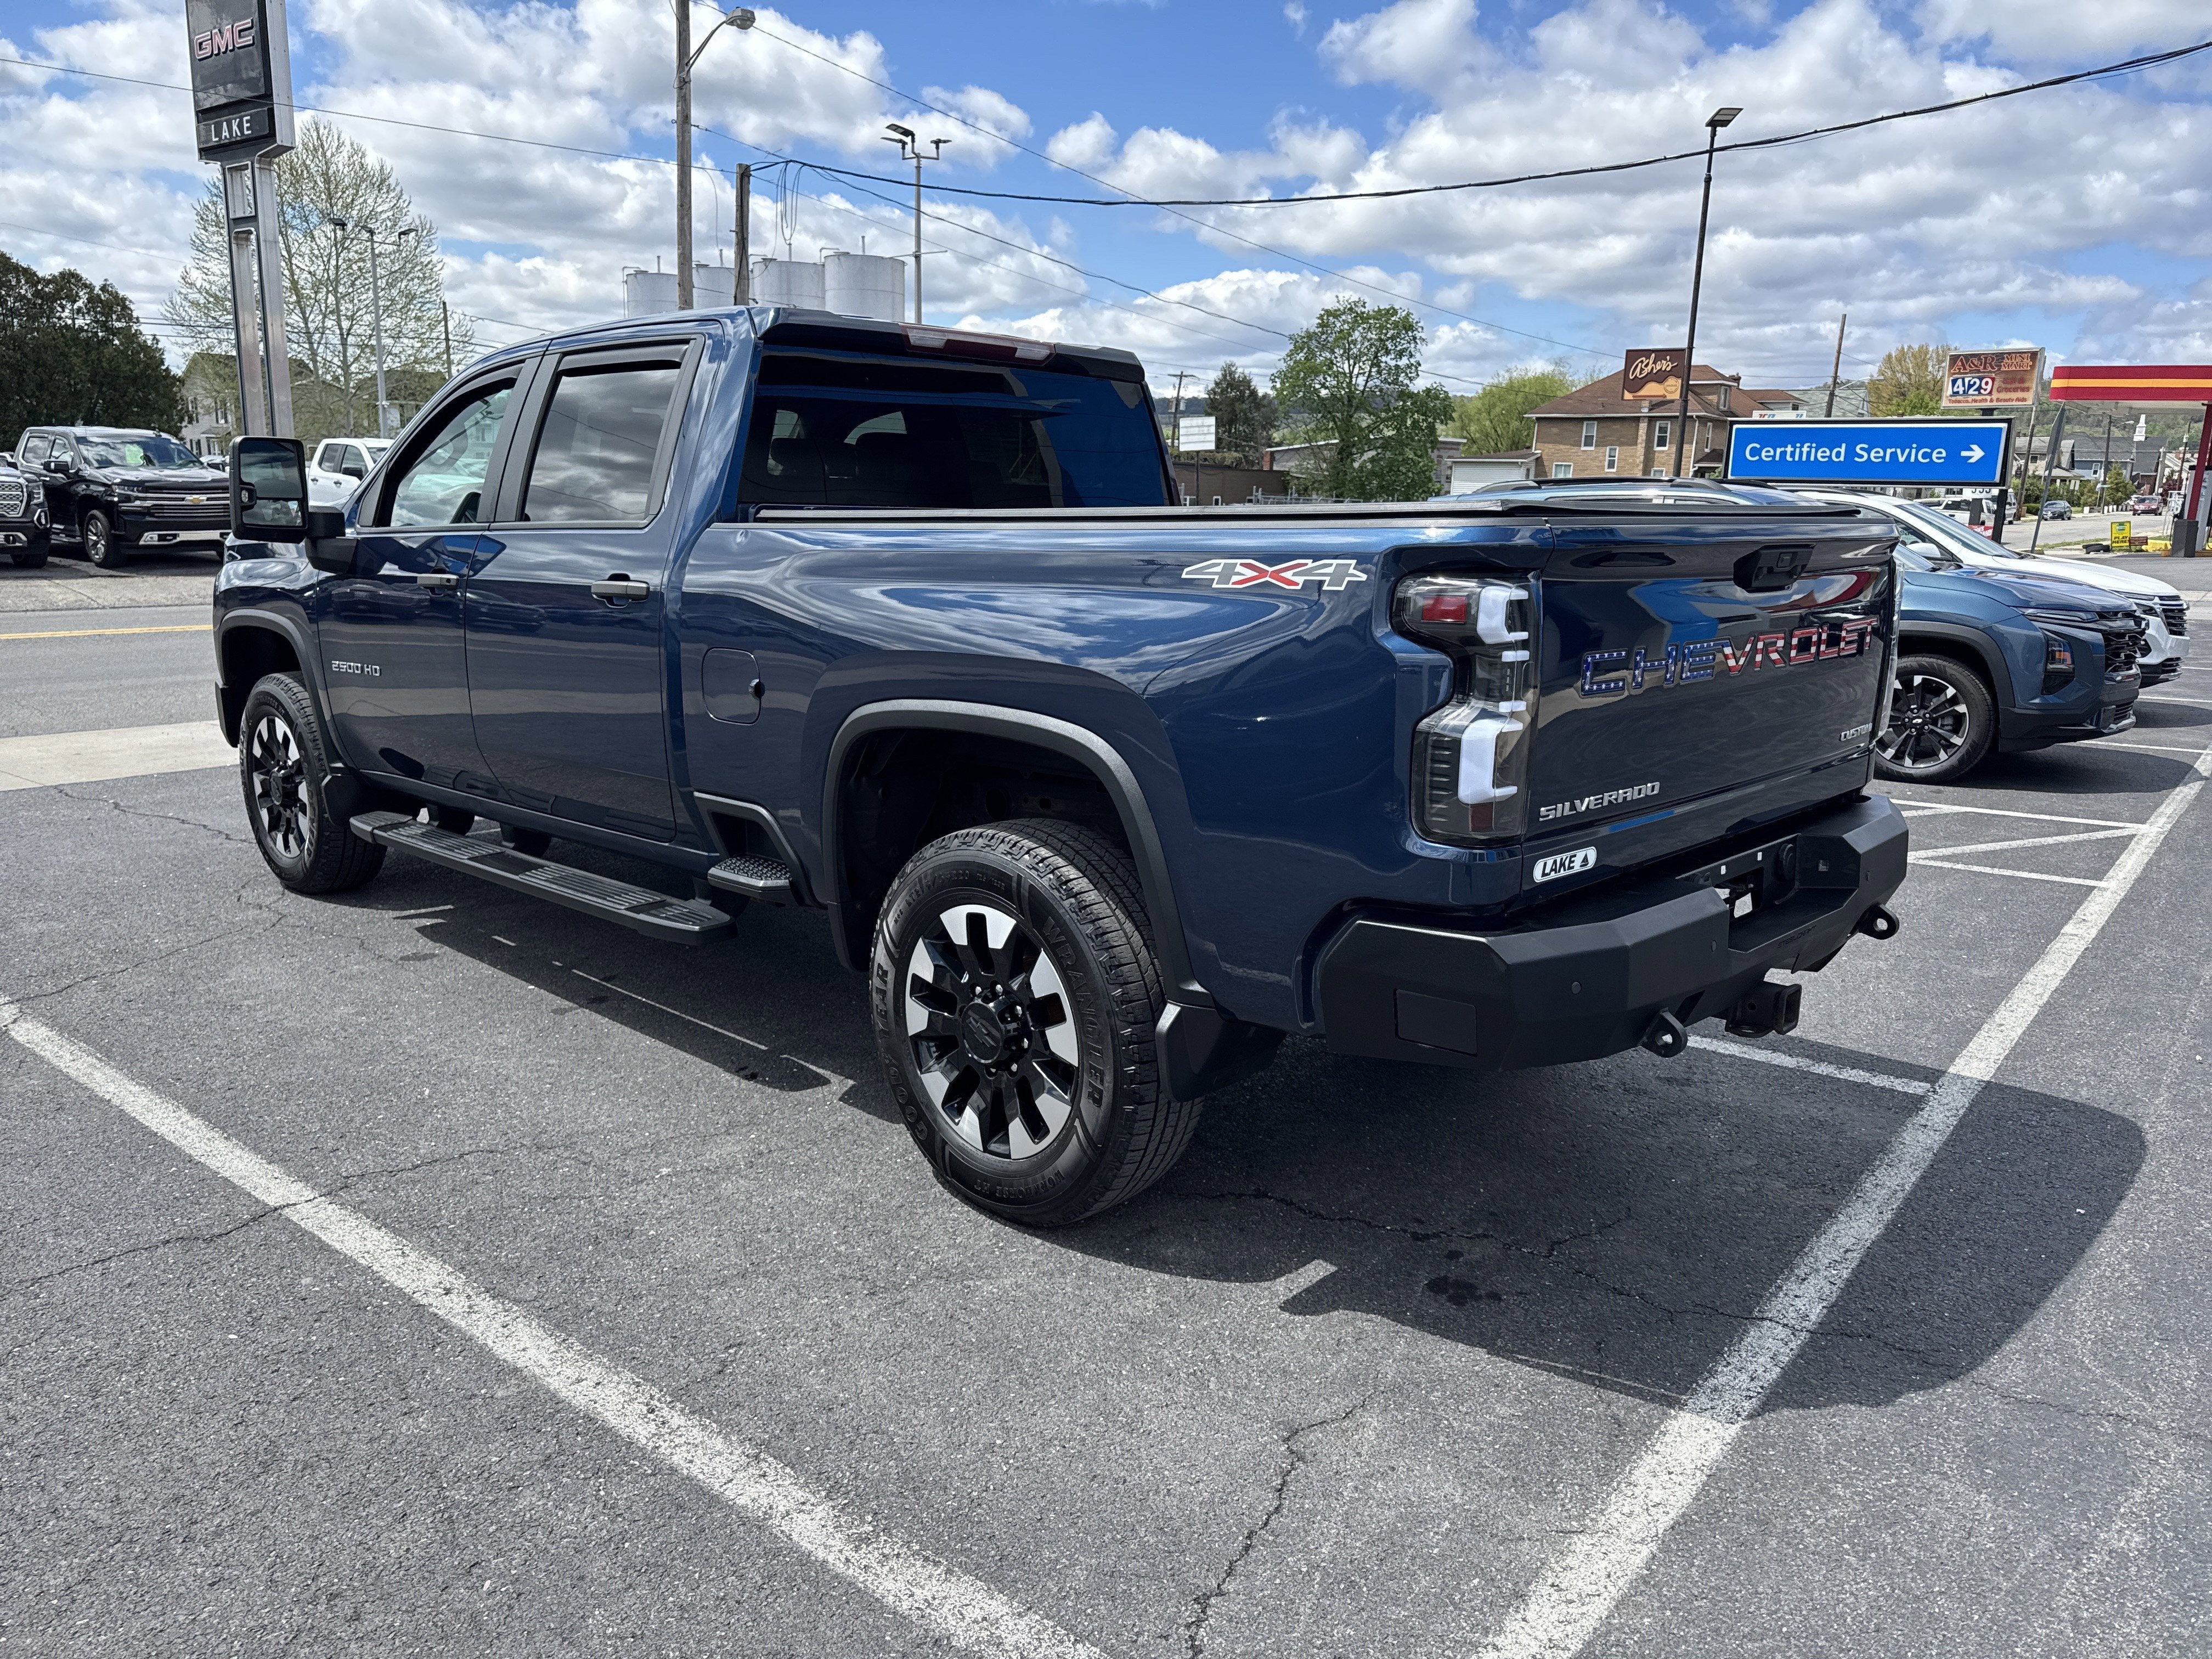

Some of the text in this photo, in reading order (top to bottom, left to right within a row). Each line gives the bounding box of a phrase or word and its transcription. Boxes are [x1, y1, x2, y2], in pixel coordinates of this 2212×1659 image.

[194, 18, 254, 60] GMC
[211, 116, 252, 142] LAKE
[1951, 355, 1997, 373] A&R
[2001, 362, 2032, 371] MART
[2004, 353, 2031, 362] MINI
[1745, 443, 1947, 463] Certified Service
[331, 661, 381, 676] 2500 HD
[1580, 618, 1878, 698] CHEVROLET
[1539, 782, 1661, 822] SILVERADO
[1542, 854, 1577, 878] LAKE
[1041, 916, 1104, 1108] WRANGLER
